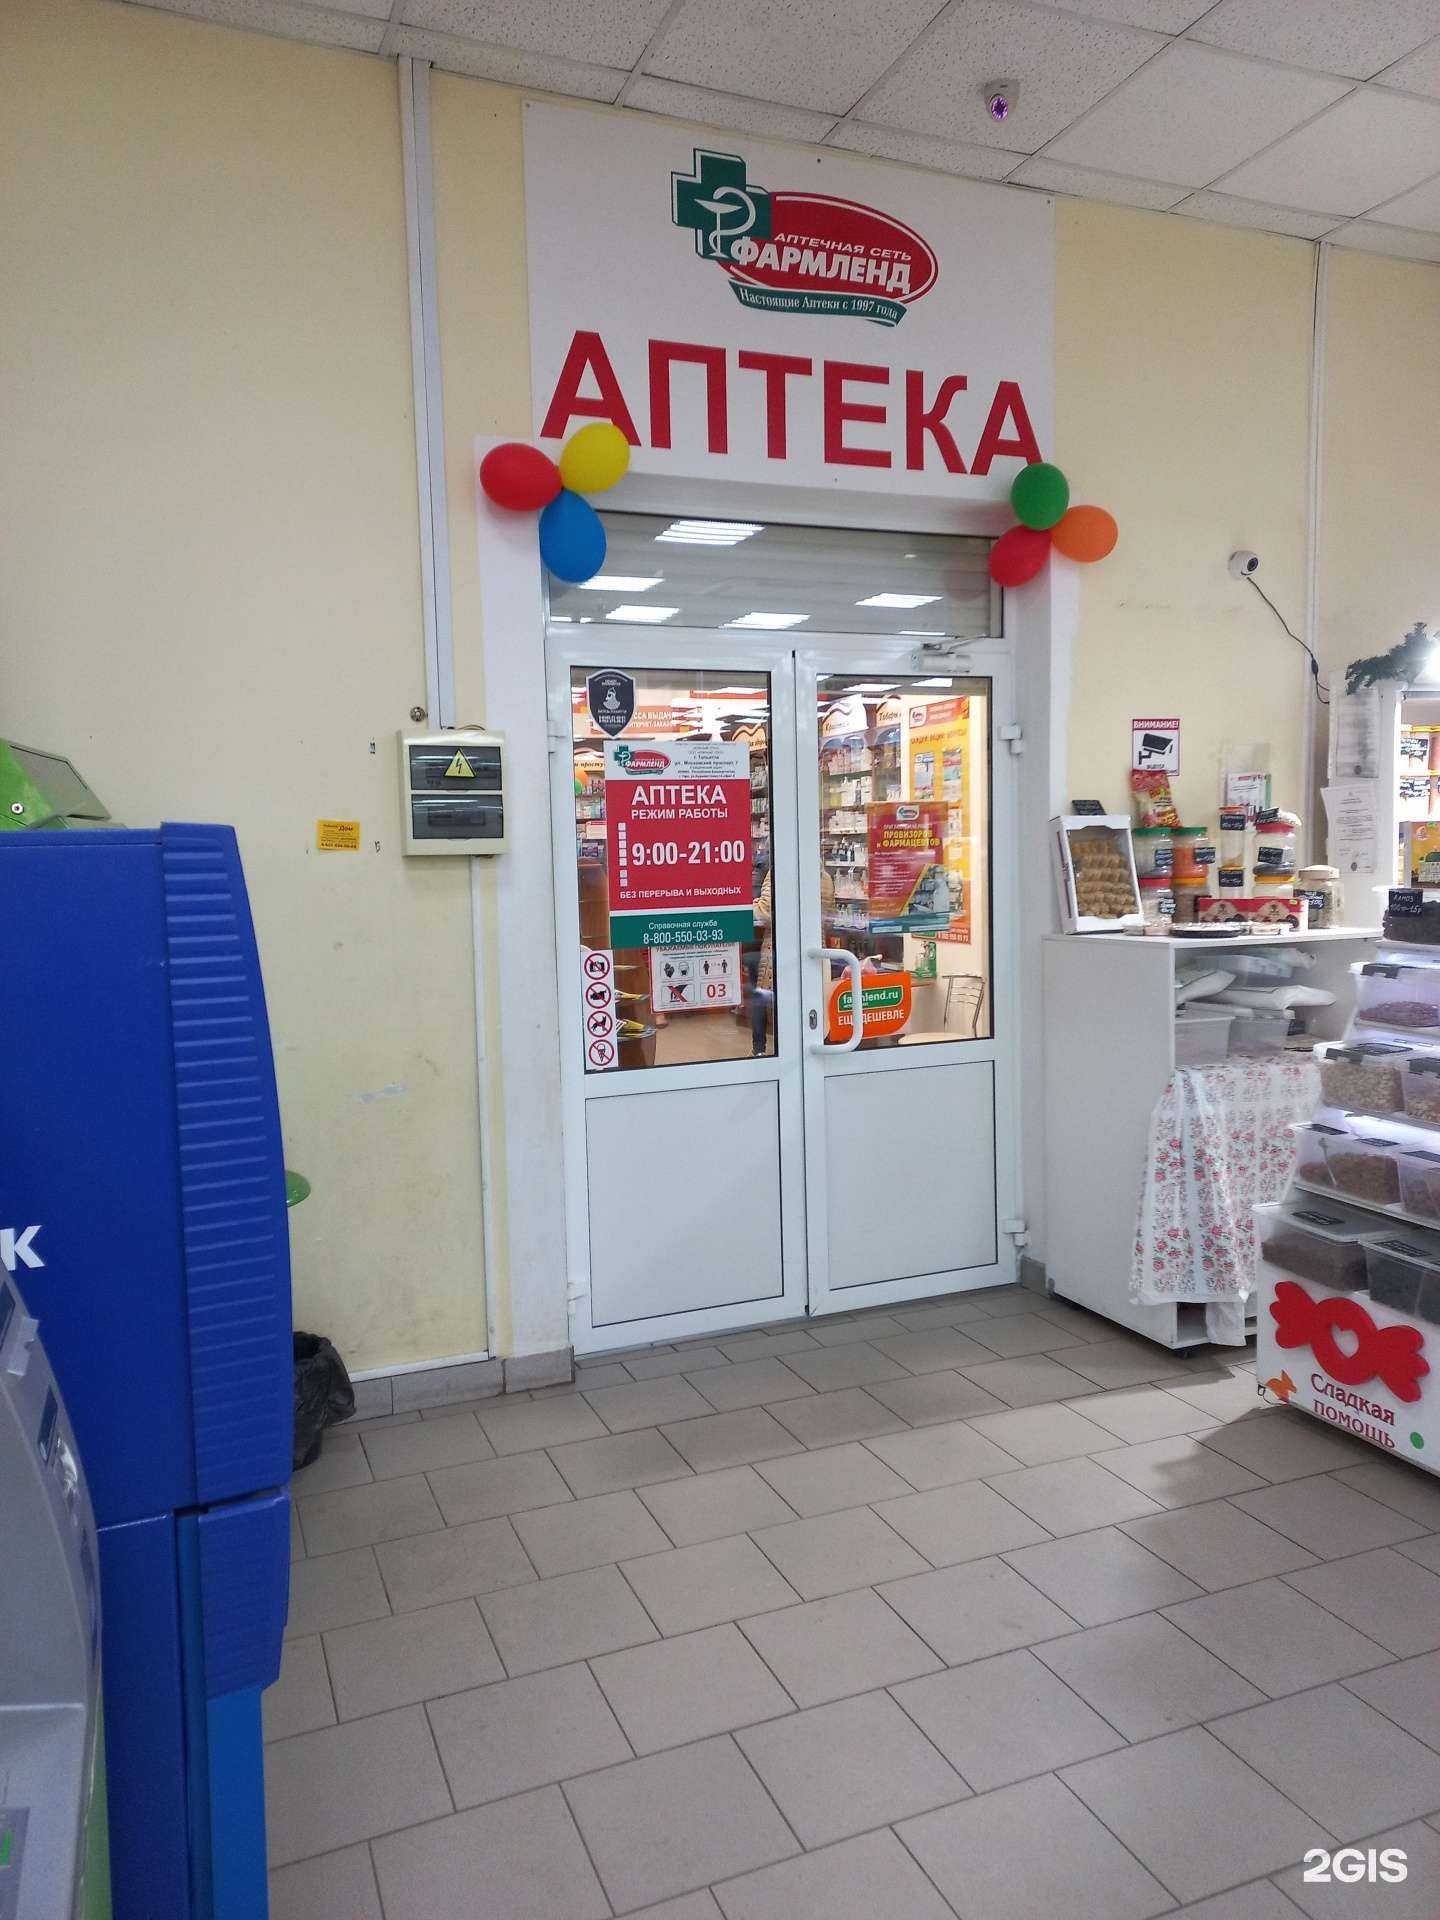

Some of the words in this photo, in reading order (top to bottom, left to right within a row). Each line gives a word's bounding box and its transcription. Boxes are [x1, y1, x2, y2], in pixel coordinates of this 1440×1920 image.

[774, 232, 865, 254] АПТЕЧНАЯ
[869, 247, 912, 261] СЕТЬ
[730, 236, 911, 294] ФАРМЛЕНД
[738, 288, 799, 309] Настоящие
[803, 296, 840, 310] Аптеки
[842, 301, 849, 310] с
[851, 299, 875, 312] 1997
[876, 304, 899, 320] года
[540, 329, 1043, 477] АПТЕКА
[1133, 720, 1179, 730] ВНИМАНИЕ!
[625, 758, 666, 769] ФАРМЛЕНД
[631, 785, 728, 806] АПТЕКА
[631, 808, 675, 820] РЕЖИМ
[679, 807, 728, 819] РАБОТЫ
[631, 840, 745, 866] 9:00-21:00
[619, 891, 636, 899] БЕЗ
[638, 889, 685, 898] ПЕРЕРЫВА
[694, 886, 742, 897] ВЫХОДНЫХ
[648, 920, 691, 930] Справочная
[692, 919, 718, 929] служба
[643, 929, 724, 944] 8-800-550-03-93
[706, 983, 727, 998] 03
[843, 990, 899, 1005] falend.ru
[1311, 1373, 1395, 1426] Сладкая
[1313, 1399, 1395, 1449] помощь
